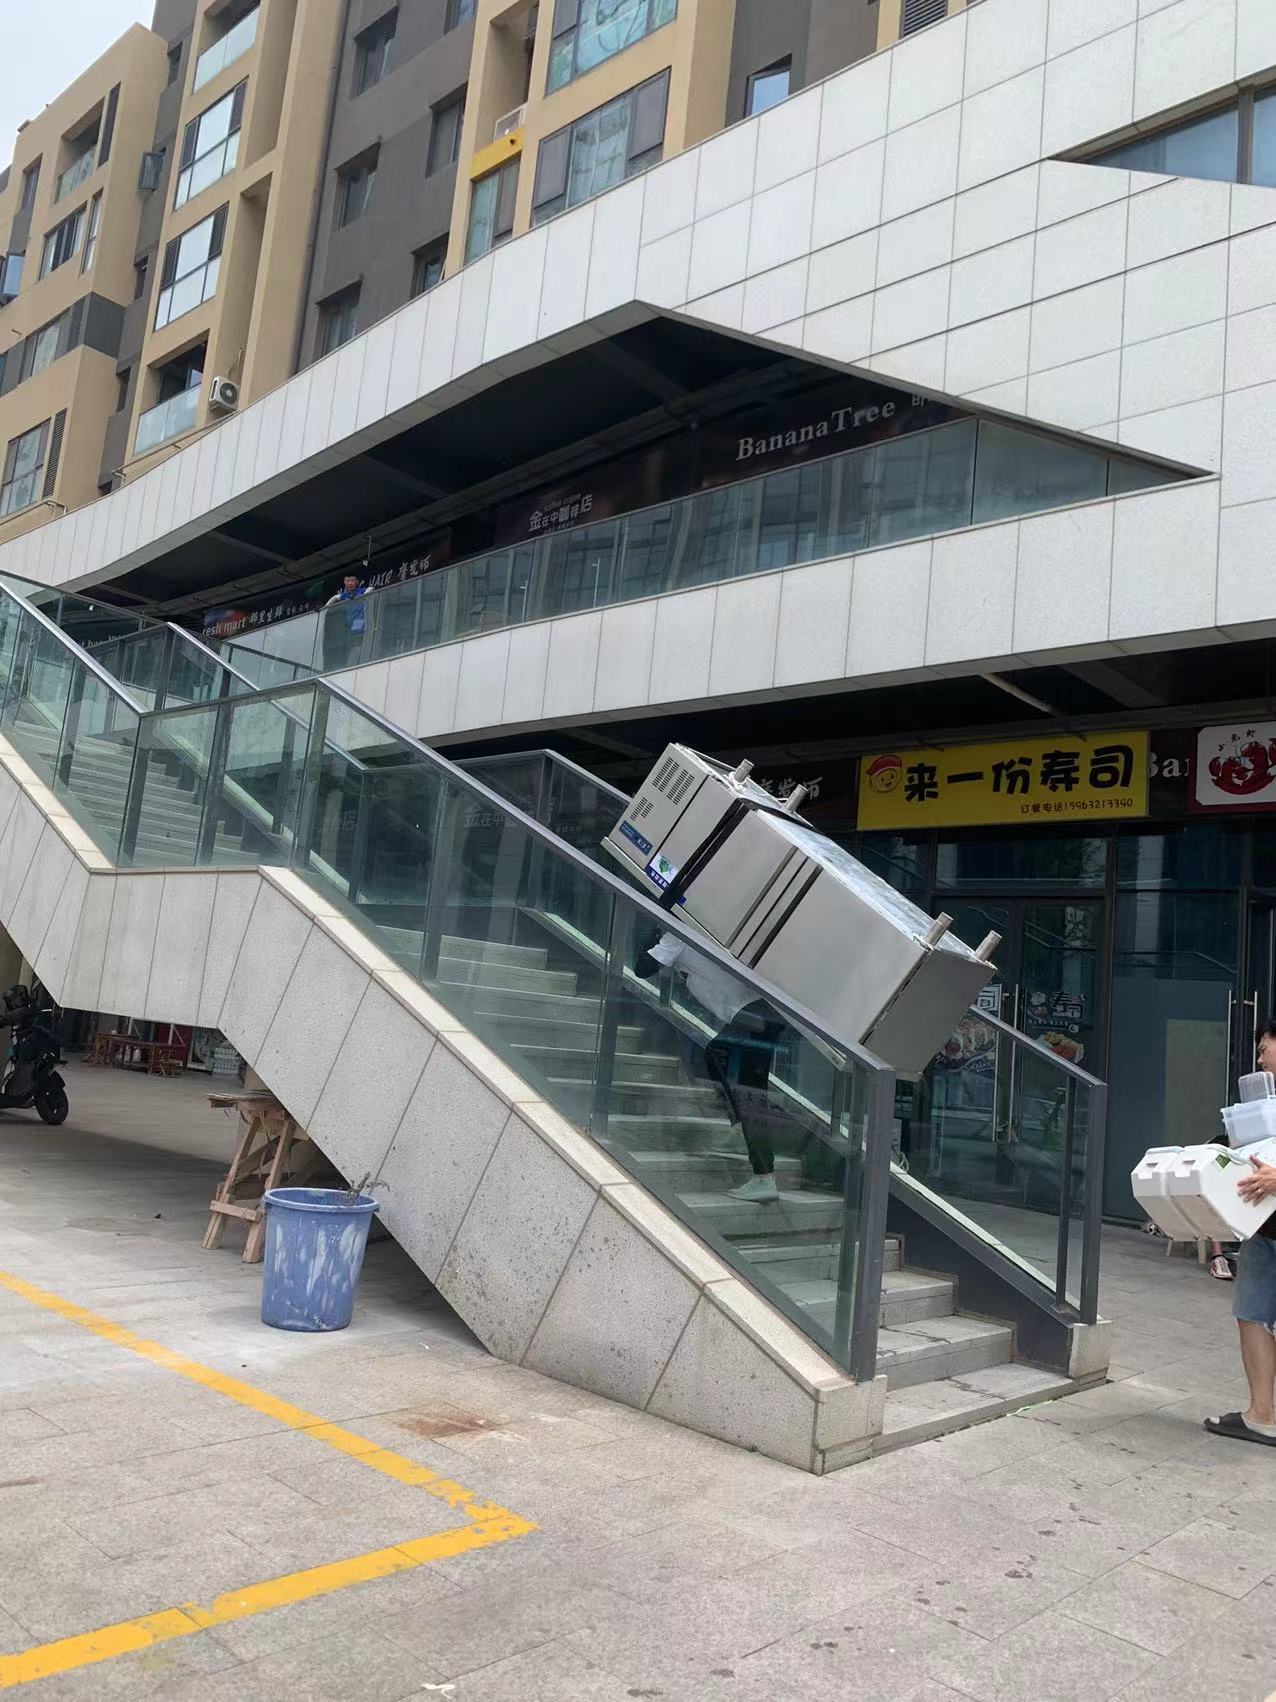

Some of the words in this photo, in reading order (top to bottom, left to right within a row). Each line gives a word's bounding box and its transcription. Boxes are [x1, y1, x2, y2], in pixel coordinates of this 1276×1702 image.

[223, 617, 247, 633] mart
[904, 744, 1135, 803] 来一份寿司
